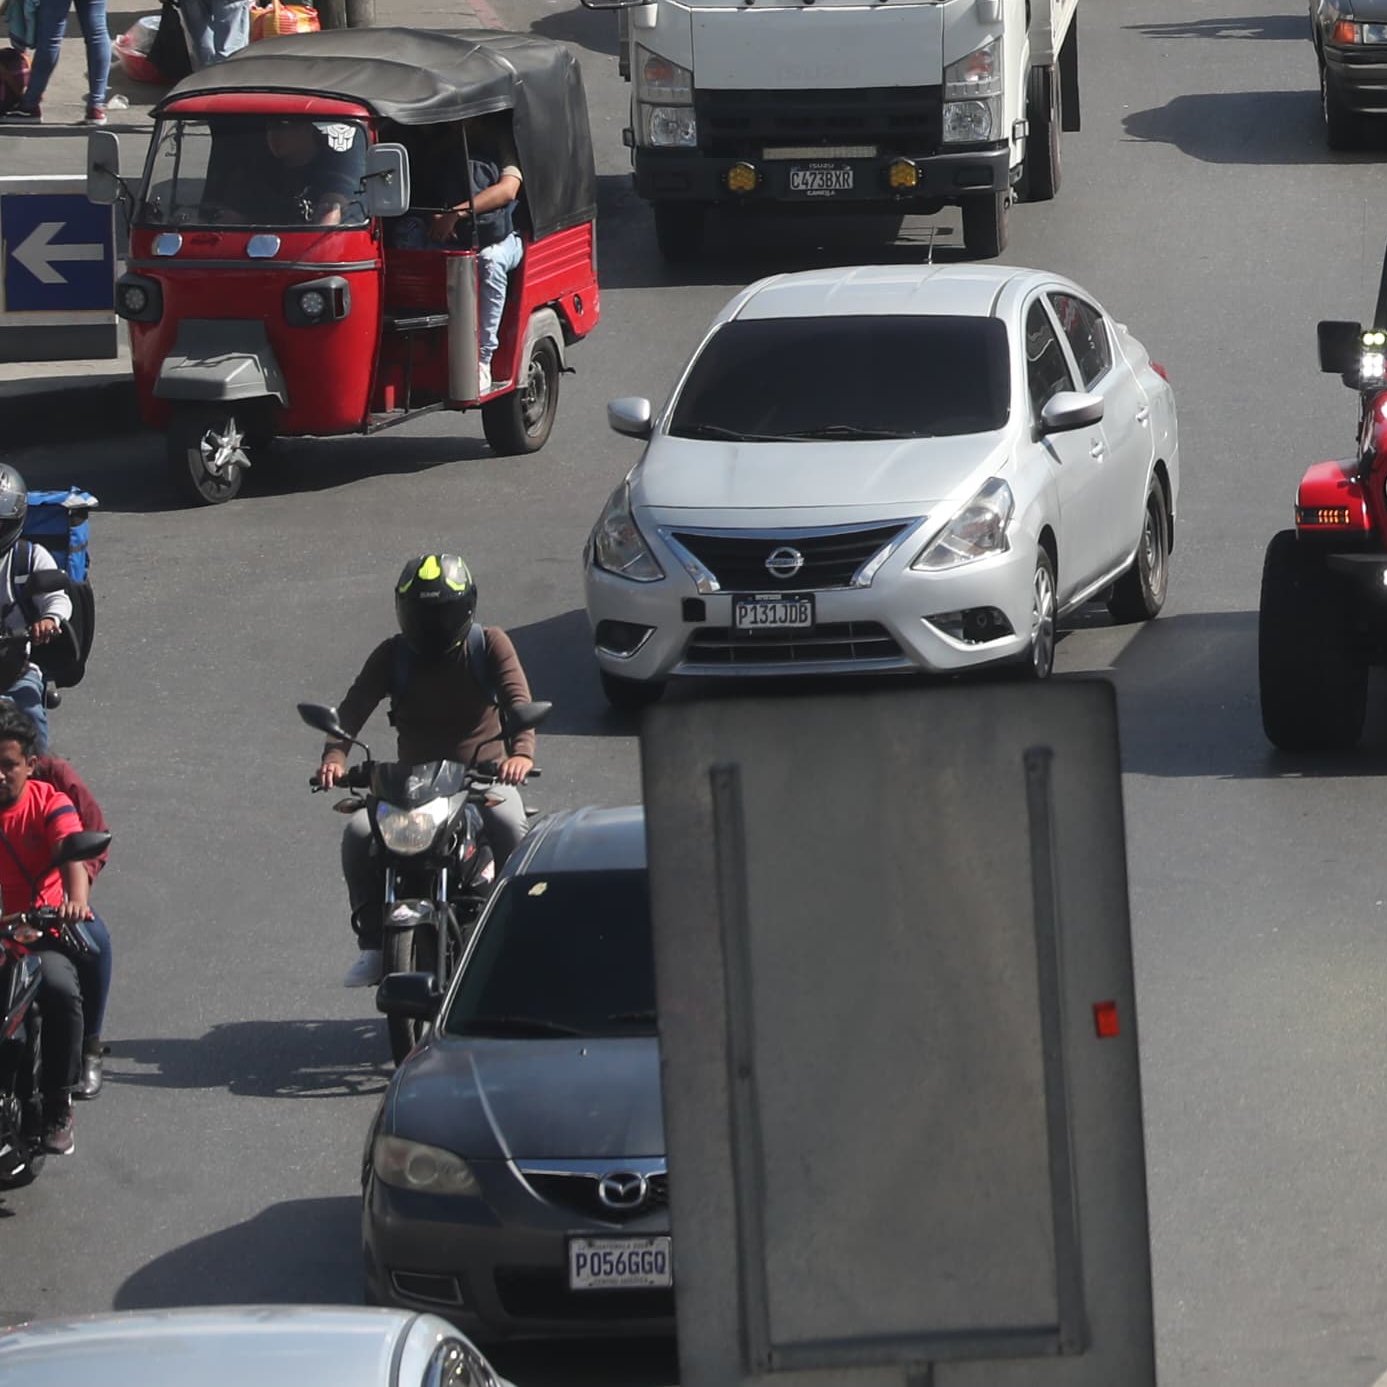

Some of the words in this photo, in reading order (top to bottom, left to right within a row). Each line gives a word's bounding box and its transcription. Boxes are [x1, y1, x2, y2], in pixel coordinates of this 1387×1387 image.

[790, 171, 853, 190] C473BXR
[737, 603, 810, 626] P131JDB
[575, 1250, 667, 1277] P056GGQ
